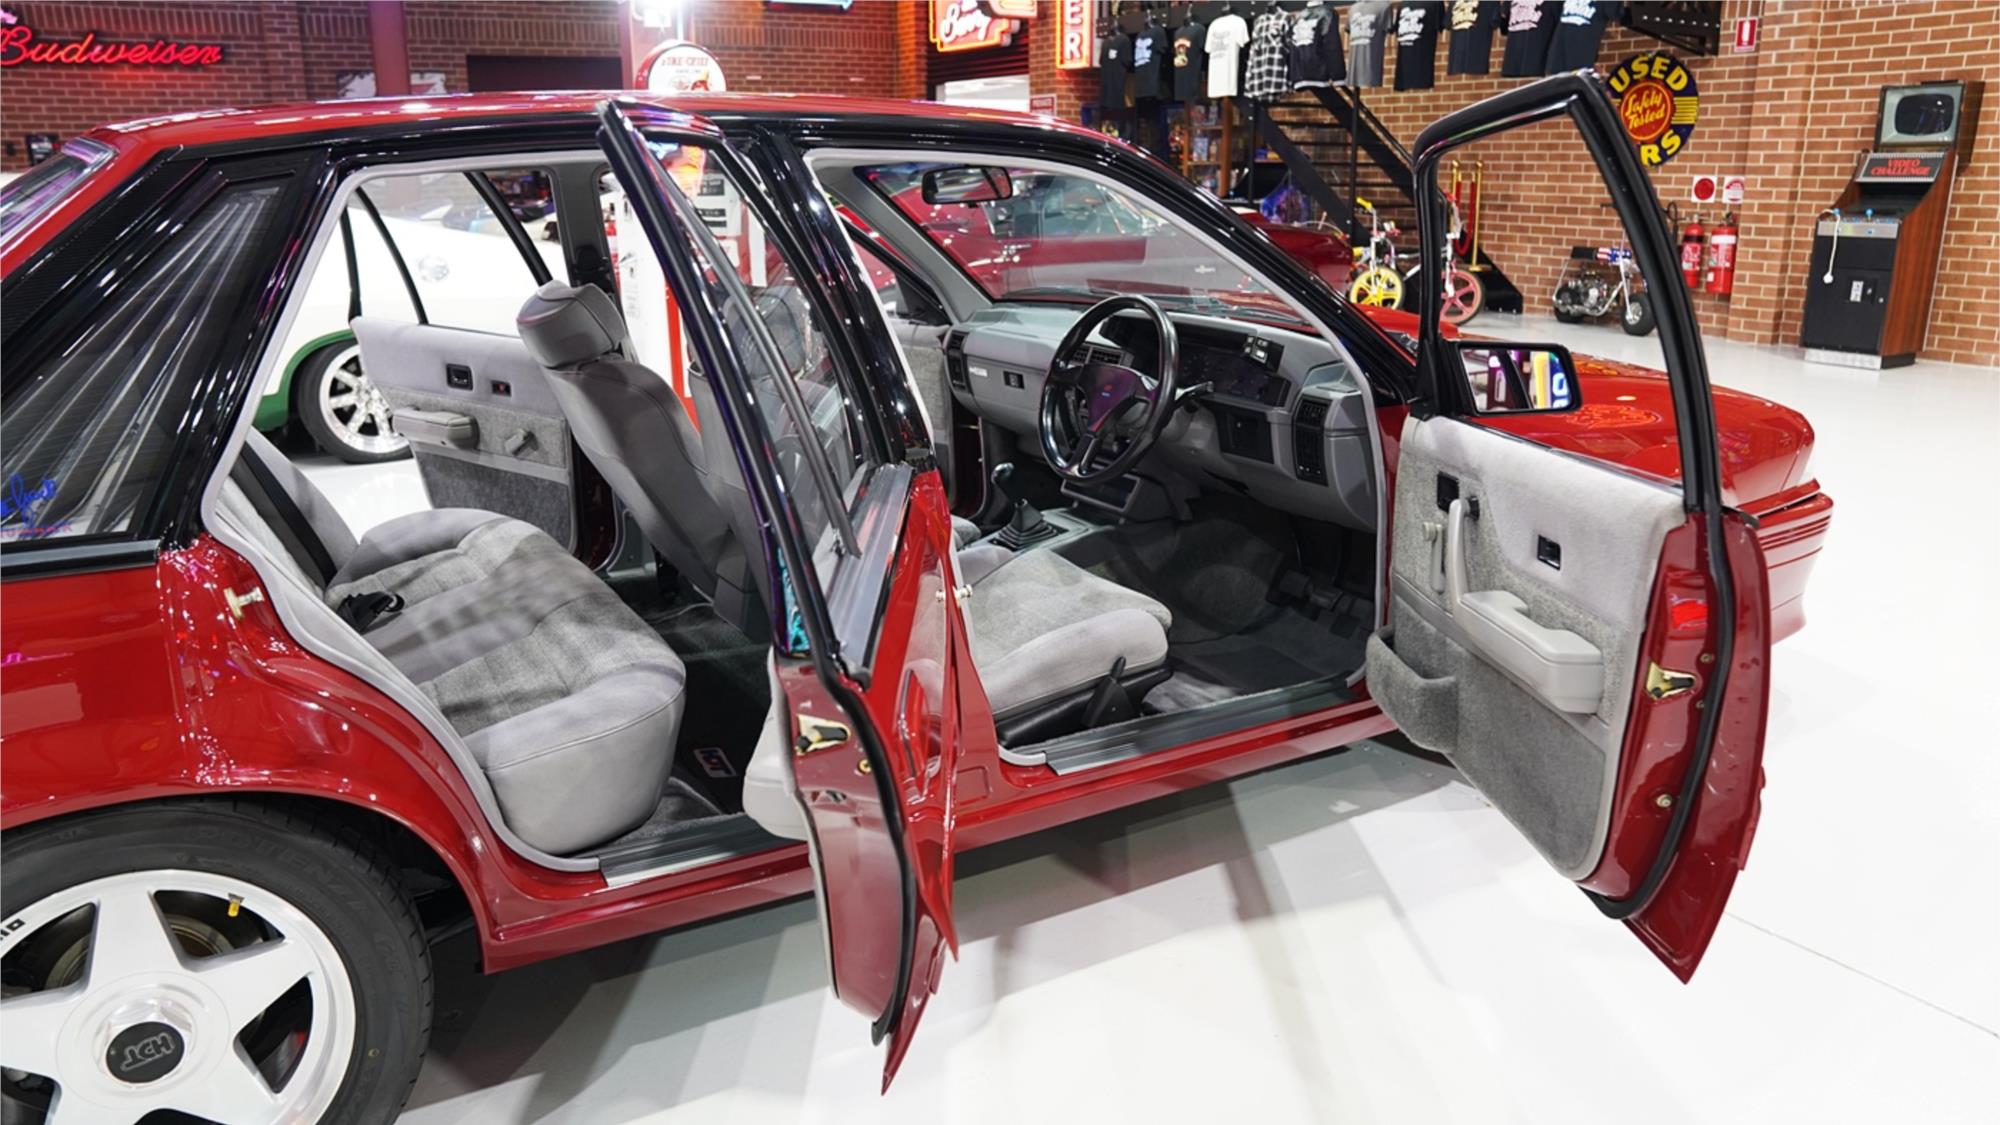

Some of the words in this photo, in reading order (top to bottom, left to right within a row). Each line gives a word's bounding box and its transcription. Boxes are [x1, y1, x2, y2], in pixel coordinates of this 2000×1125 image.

[0, 26, 222, 66] Budweiser
[1609, 55, 1689, 92] USED
[1625, 90, 1663, 117] Safety
[1628, 104, 1666, 129] Tested
[1640, 129, 1681, 165] RS
[1871, 166, 1930, 176] CHALLENGE
[1888, 158, 1921, 168] VIDEO
[119, 1032, 175, 1072] HDT
